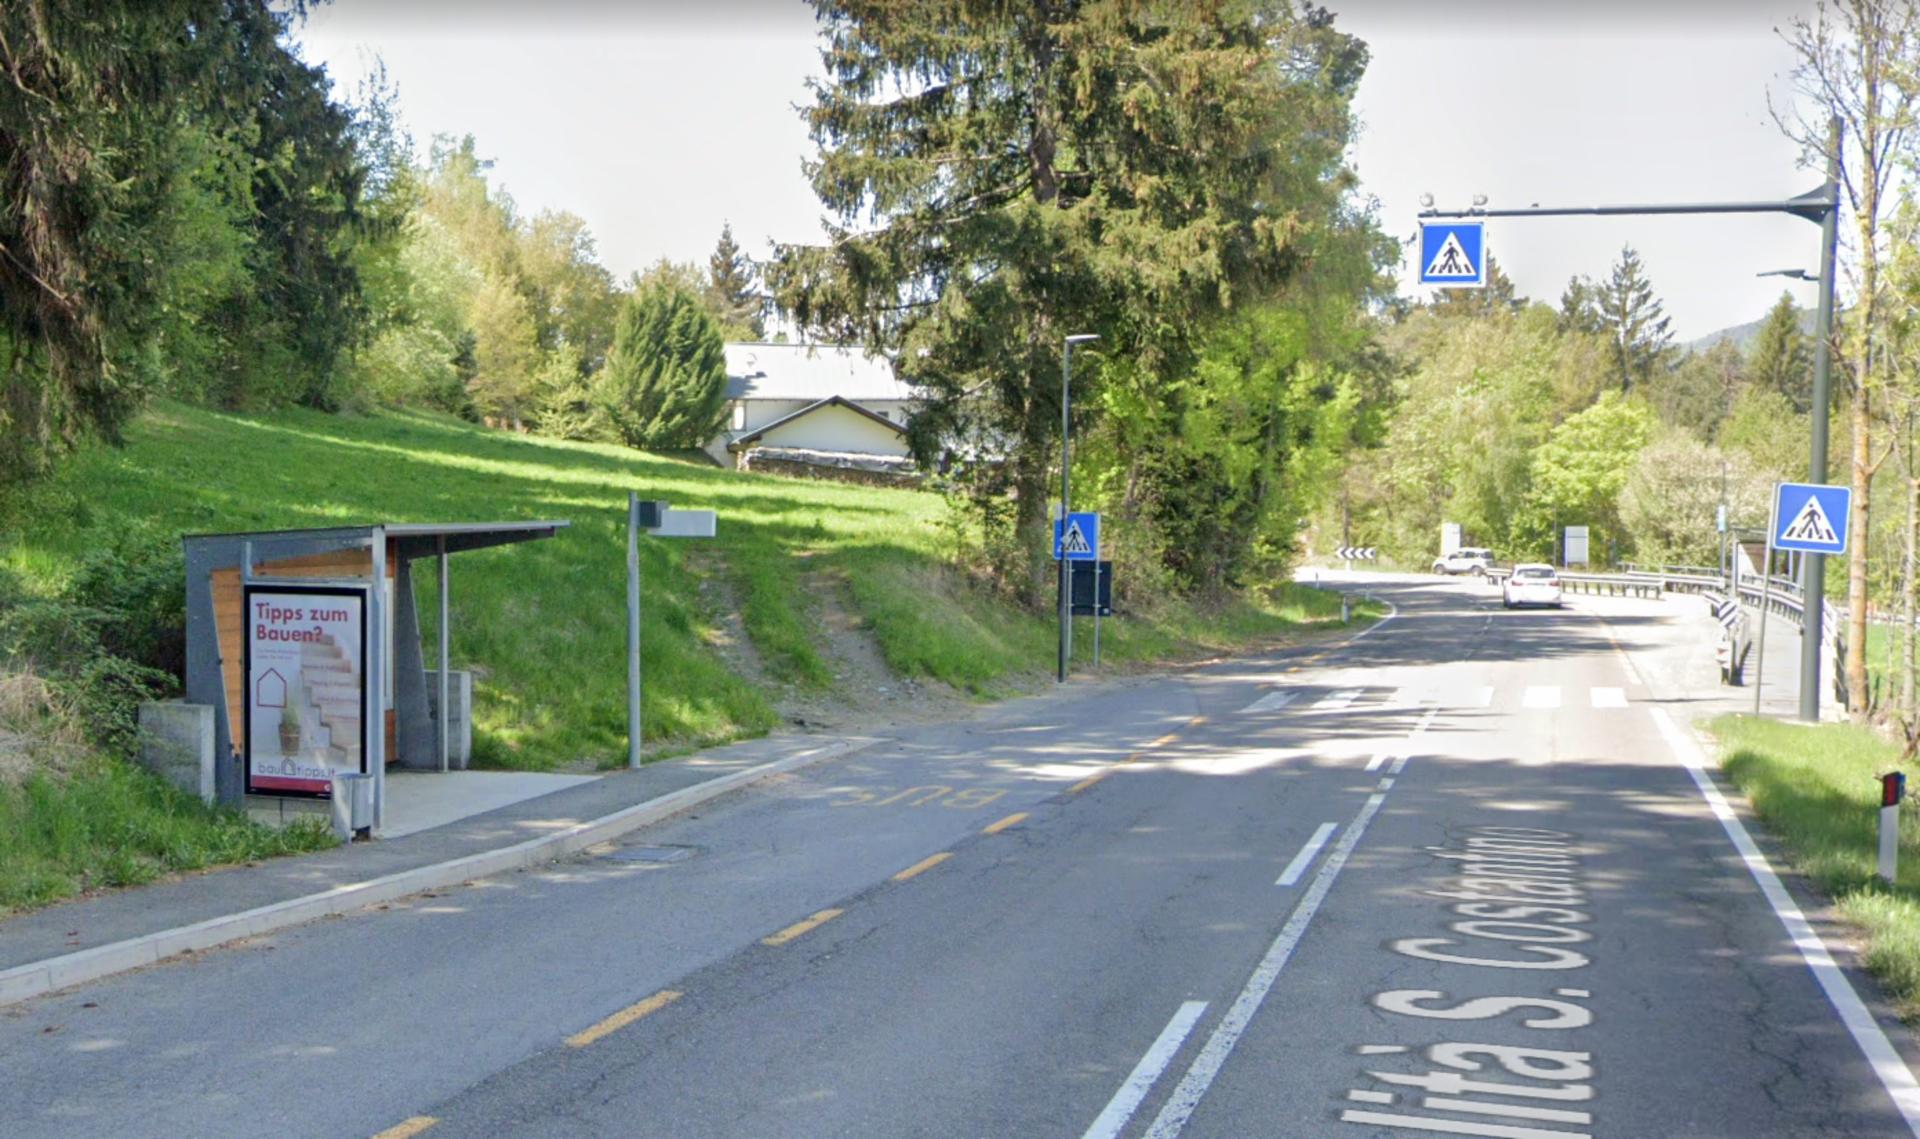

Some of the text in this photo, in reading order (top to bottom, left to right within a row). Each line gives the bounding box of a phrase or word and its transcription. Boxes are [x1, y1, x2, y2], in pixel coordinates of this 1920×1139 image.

[256, 603, 348, 624] Tipps zum
[256, 624, 323, 643] Bauen?
